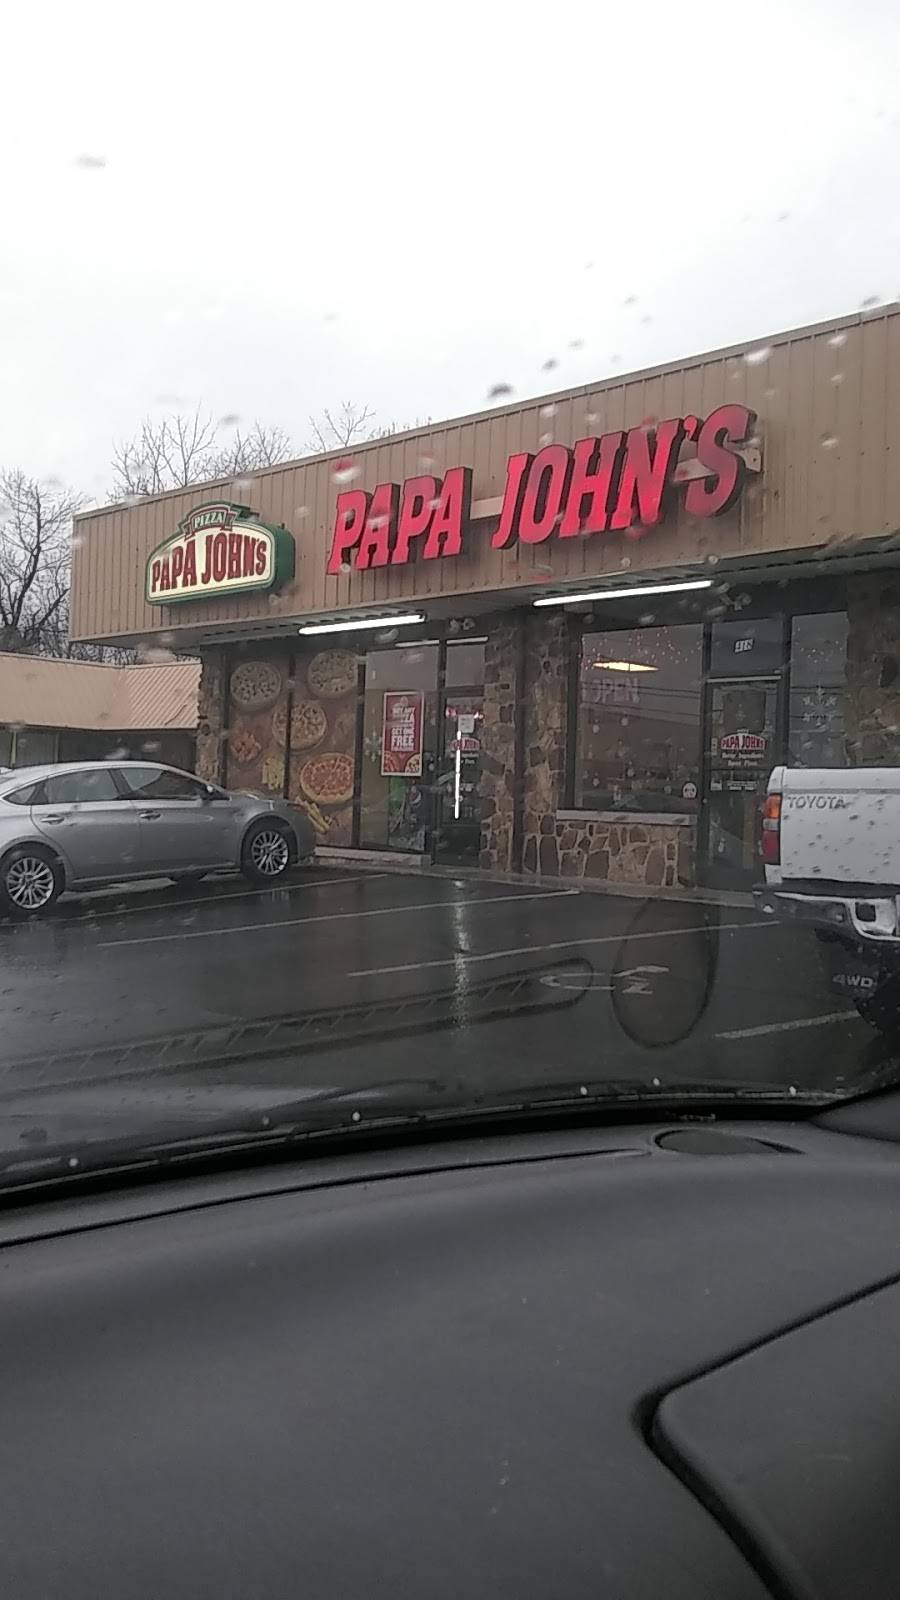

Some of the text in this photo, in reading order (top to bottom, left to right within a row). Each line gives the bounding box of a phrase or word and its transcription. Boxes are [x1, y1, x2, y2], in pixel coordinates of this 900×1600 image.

[326, 404, 756, 576] PAPA JOHN'S
[194, 511, 224, 528] PIZZA
[152, 532, 267, 593] PAPA JOHN'S
[391, 734, 414, 748] FREE
[787, 796, 846, 809] TOYOTA
[832, 975, 874, 988] 4WD
